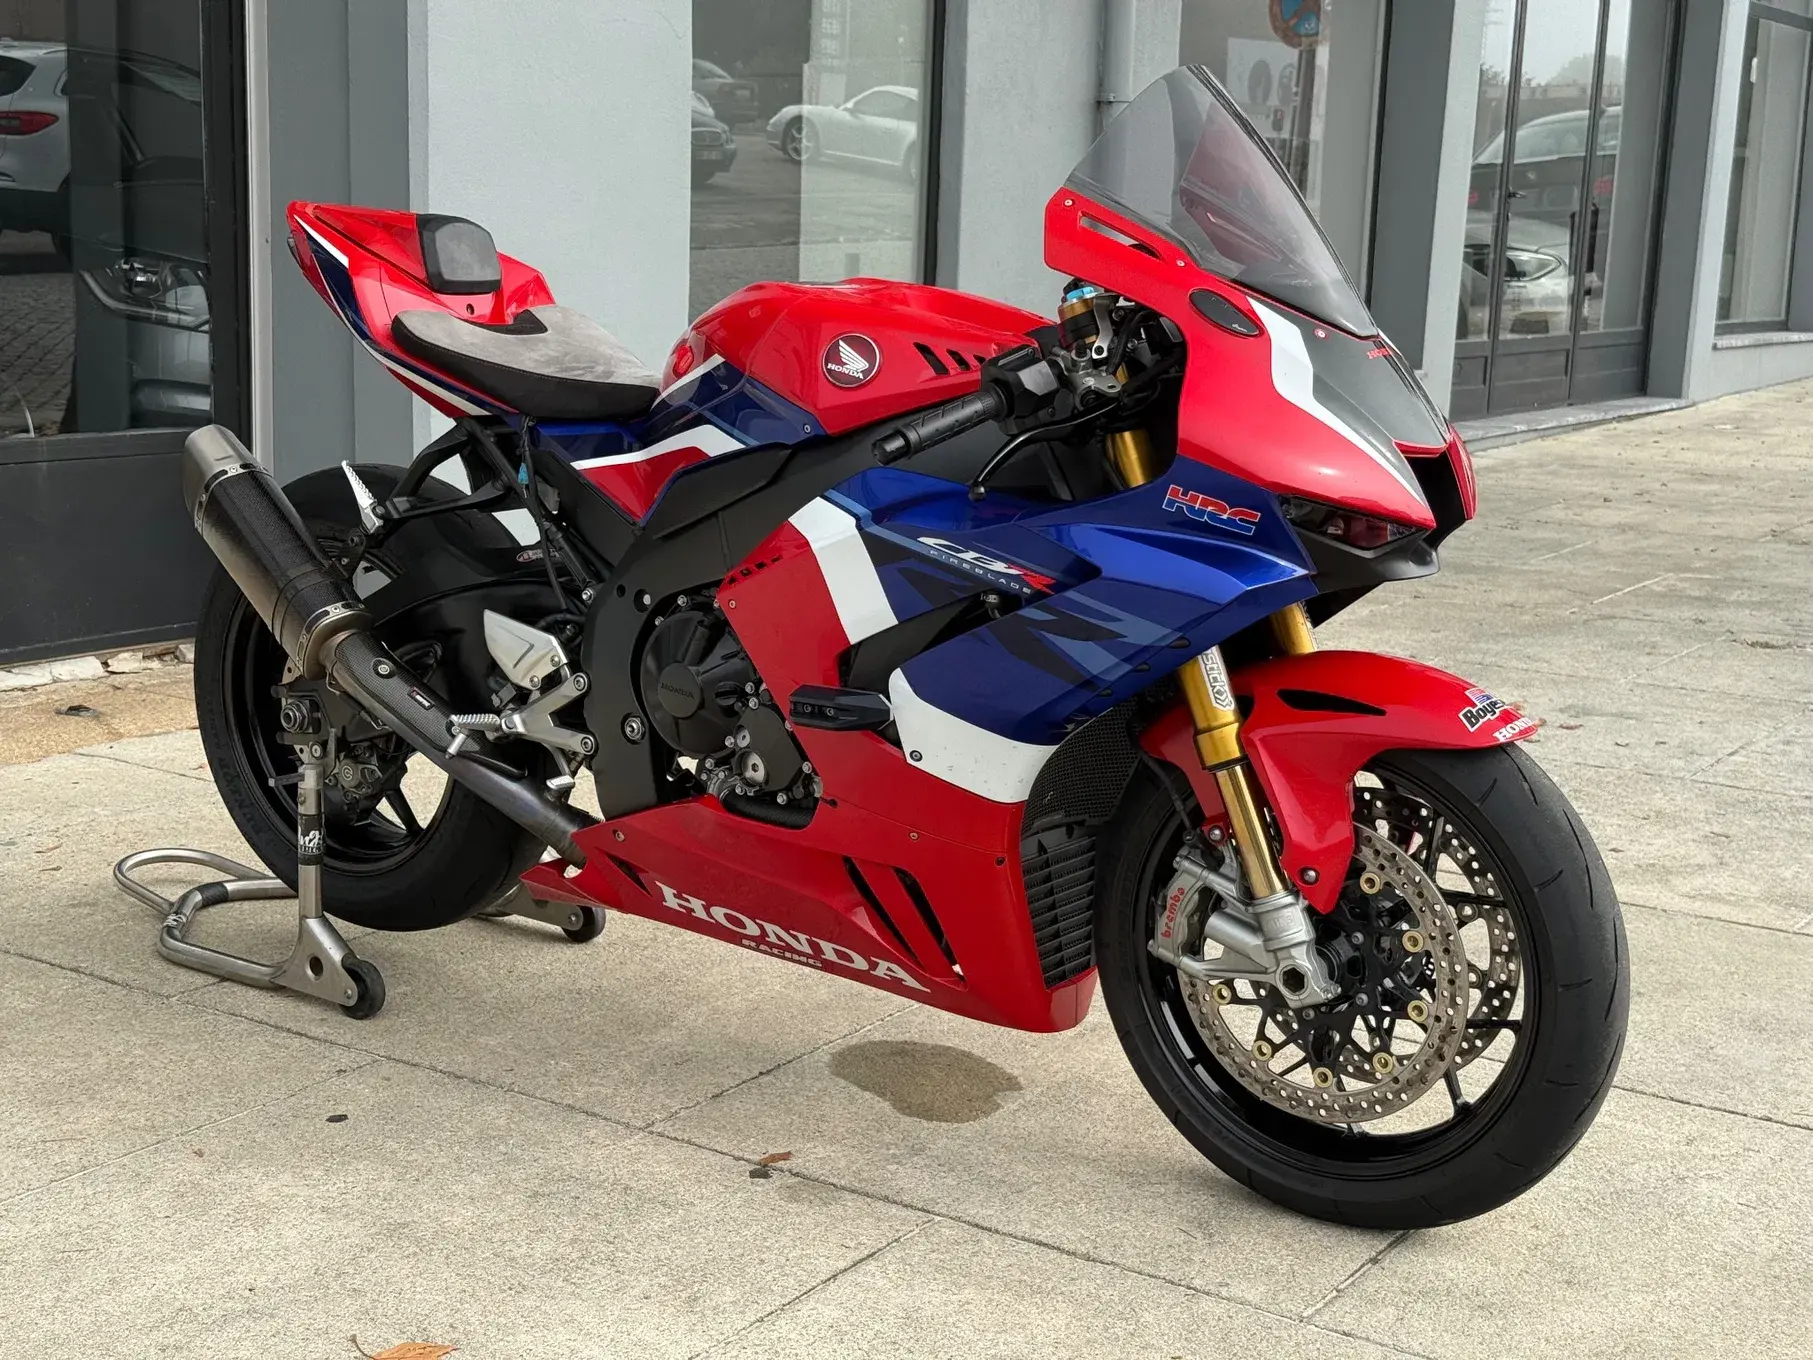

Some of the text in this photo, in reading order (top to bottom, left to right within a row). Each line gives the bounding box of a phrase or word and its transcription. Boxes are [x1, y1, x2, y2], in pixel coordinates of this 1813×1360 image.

[827, 362, 864, 380] HONDA
[1162, 484, 1261, 536] HRC
[930, 550, 1033, 594] FIREBLADE
[661, 682, 695, 700] HONDA
[1160, 887, 1185, 939] brembo
[655, 881, 931, 993] HONDA
[741, 938, 823, 968] RACING
